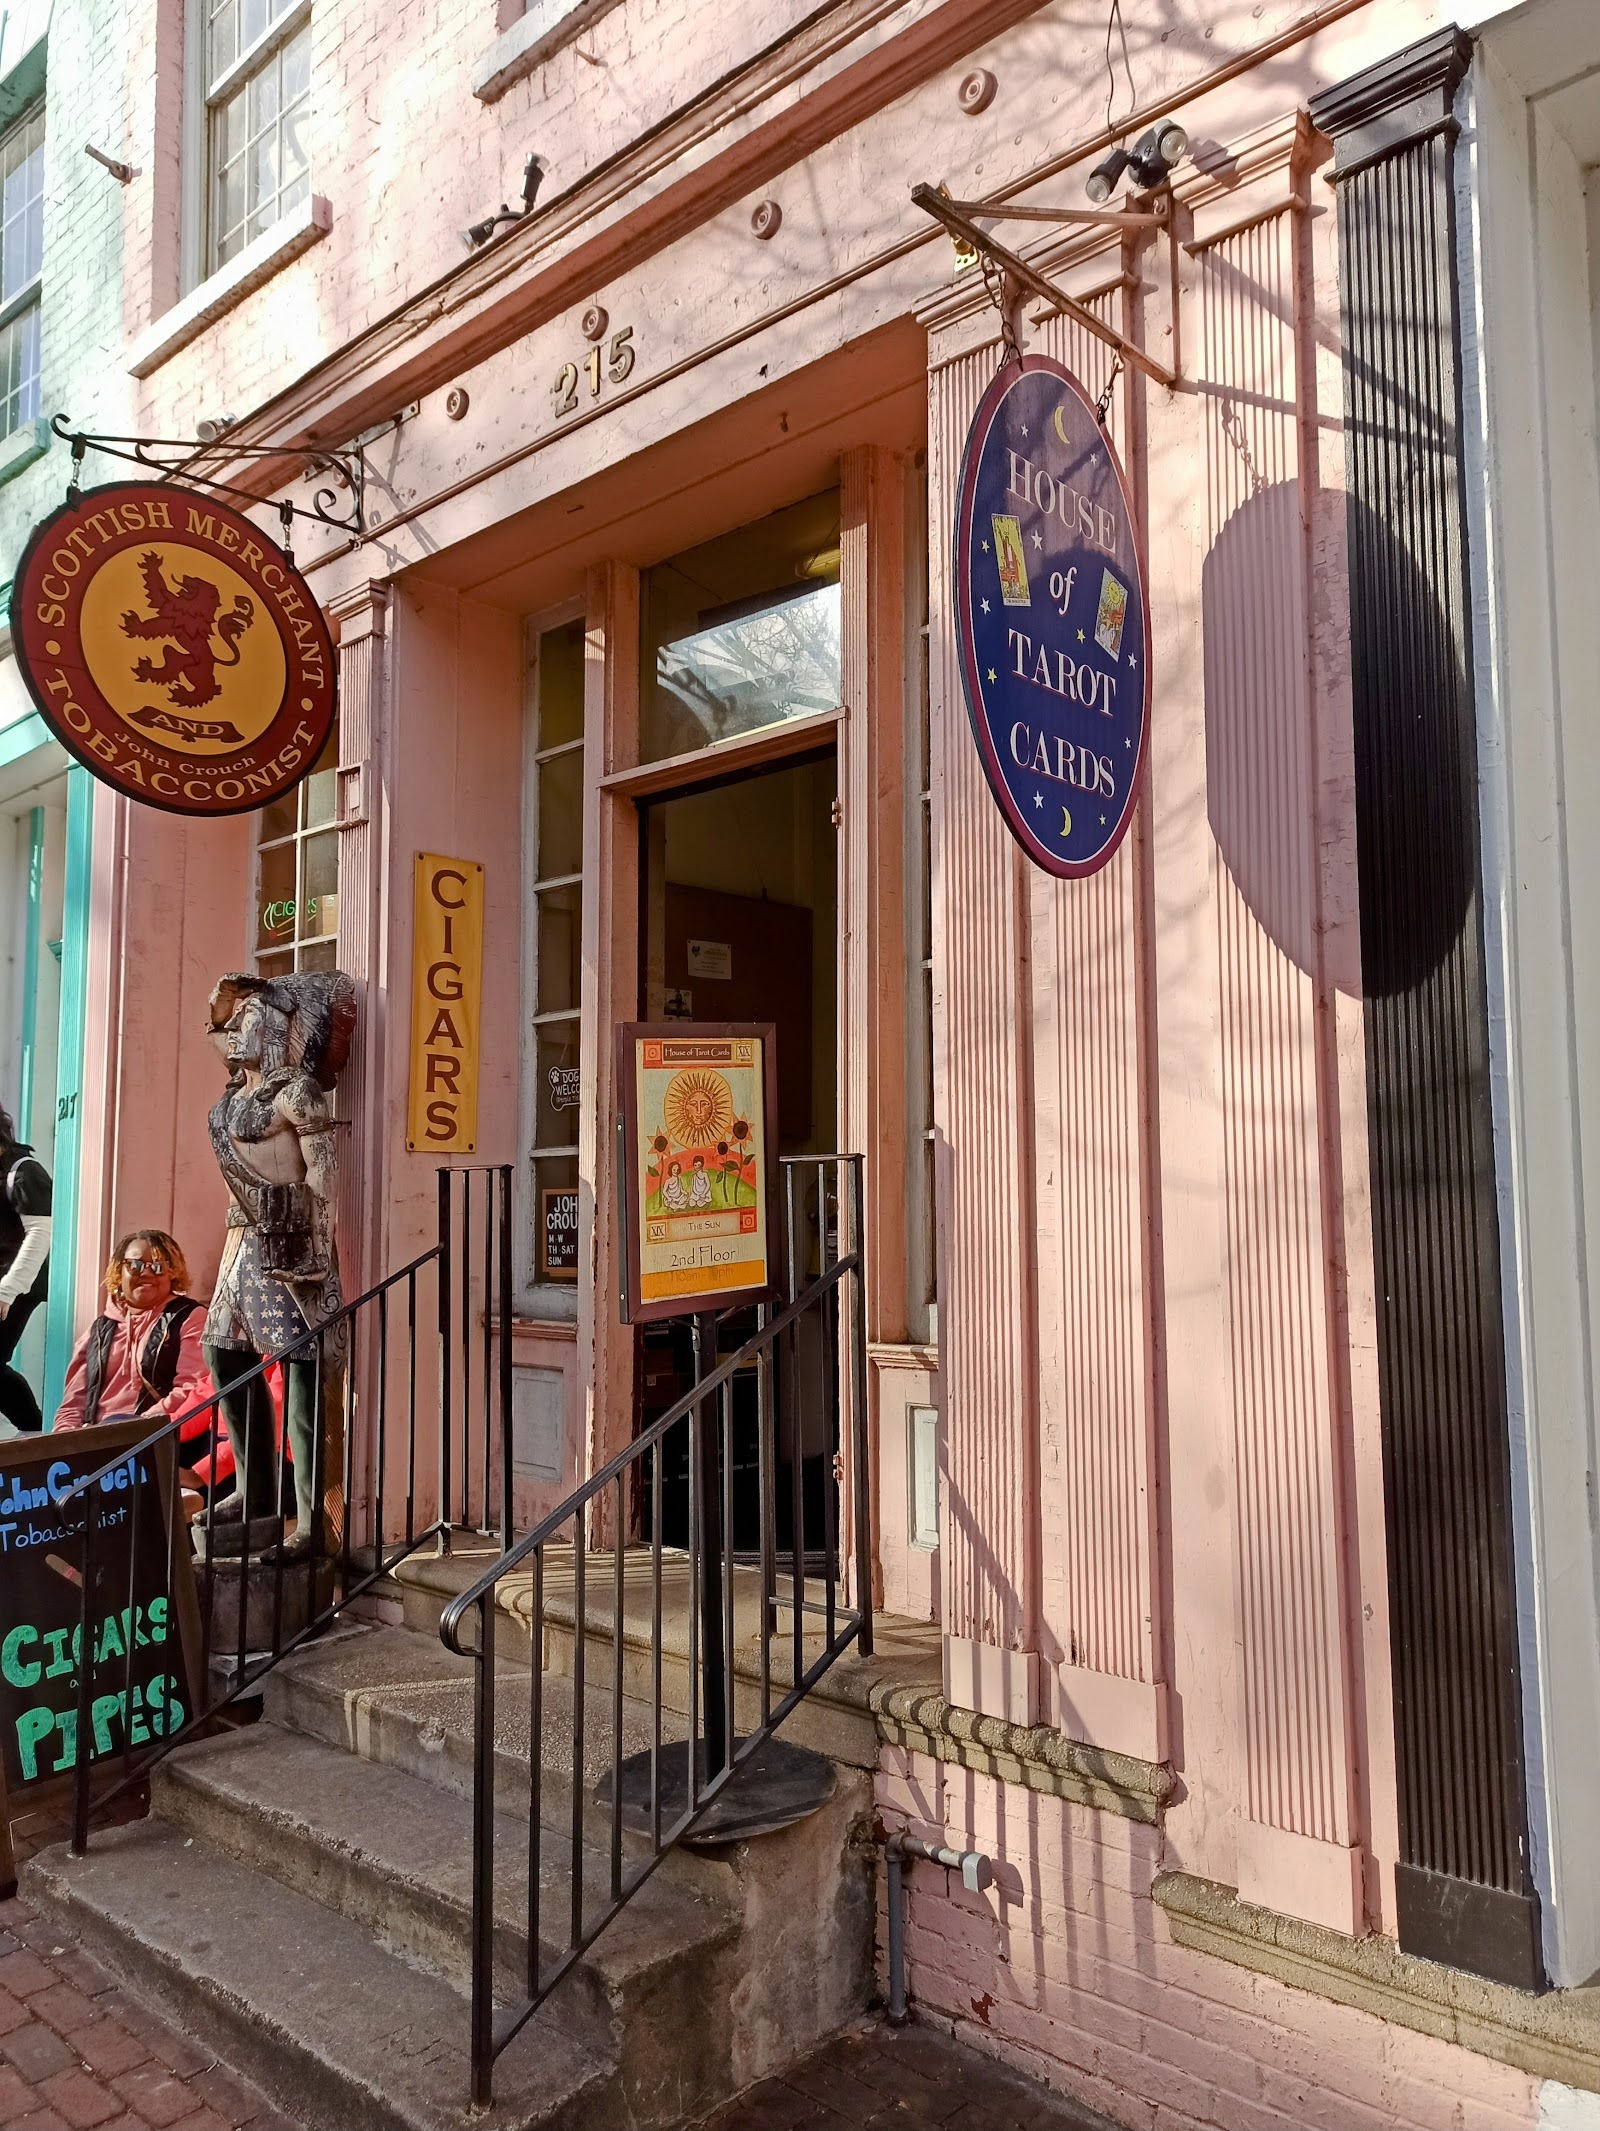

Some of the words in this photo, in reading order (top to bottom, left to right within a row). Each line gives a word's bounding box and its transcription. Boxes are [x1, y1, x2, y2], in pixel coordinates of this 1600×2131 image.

[554, 326, 635, 419] 215
[1005, 448, 1117, 554] HOUSE
[37, 501, 174, 628] SCOTTISH
[186, 506, 325, 690] MERCHANT
[1049, 566, 1078, 615] of
[1008, 628, 1117, 717] TAROT
[45, 668, 316, 801] TOBACCONIST
[114, 730, 170, 768] John
[179, 756, 256, 776] Crouch
[150, 713, 225, 737] AND
[1010, 720, 1116, 799] CARDS
[423, 869, 468, 1141] CIGARS
[665, 1048, 686, 1056] House
[687, 1048, 694, 1056] of
[694, 1048, 710, 1057] Tarot
[711, 1047, 730, 1057] Cards
[58, 1092, 78, 1121] 217
[671, 1247, 695, 1267] 2nd
[700, 1244, 736, 1266] Floor
[688, 1222, 702, 1231] THE
[705, 1221, 720, 1229] SUN
[548, 1257, 562, 1265] SUN
[0, 1472, 48, 1515] ohn
[47, 1456, 147, 1502] Cruch
[16, 1674, 185, 1780] PIPES
